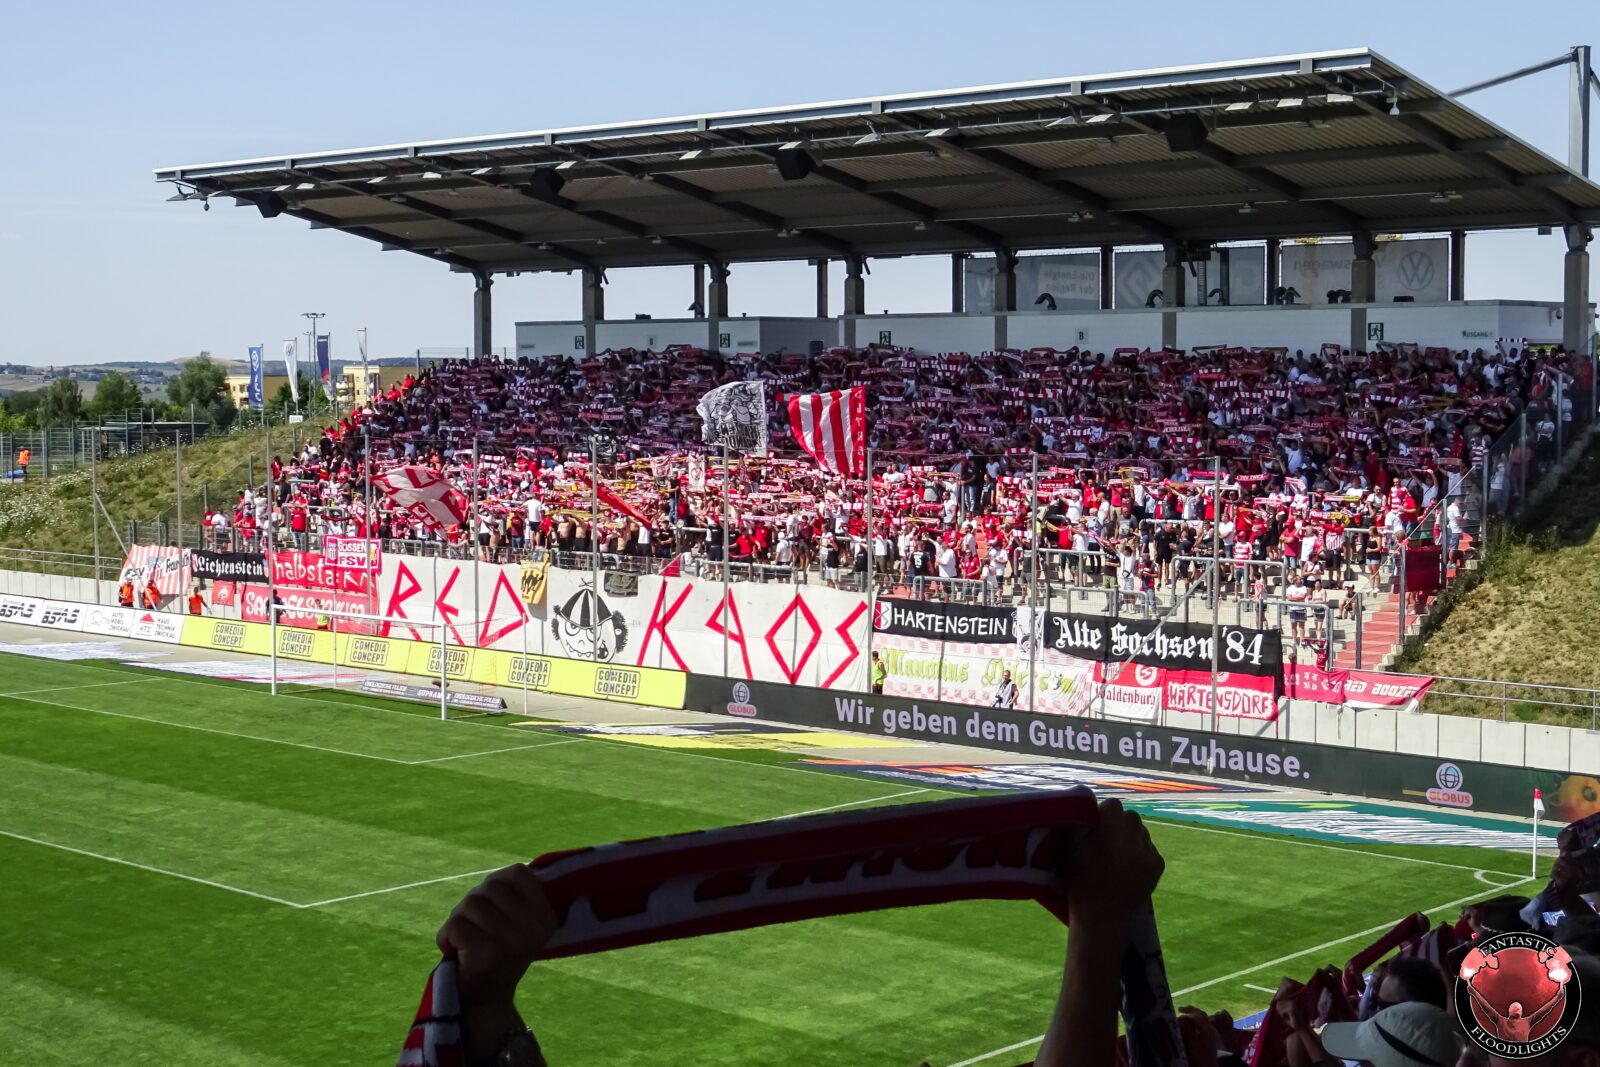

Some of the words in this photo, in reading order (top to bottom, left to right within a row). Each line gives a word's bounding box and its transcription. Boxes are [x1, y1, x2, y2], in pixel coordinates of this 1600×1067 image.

[197, 555, 263, 577] Lichtenstein
[340, 556, 366, 566] FSV
[379, 560, 529, 648] RED
[215, 623, 245, 636] COMEDIA
[893, 608, 1007, 637] HARTENSTEIN
[213, 634, 243, 645] CONCEPT
[282, 631, 313, 645] COMEDIA
[1052, 615, 1102, 650] Alte
[281, 642, 312, 655] CONCEPT
[354, 640, 387, 654] COMEDIA
[352, 651, 386, 664] CONCEPT
[429, 660, 465, 673] COCEPT
[599, 670, 637, 684] COMEDIA
[597, 681, 636, 696] CONCEPT
[728, 704, 757, 717] GLOBUS
[834, 697, 874, 726] Wir
[882, 704, 958, 736] geben
[965, 711, 1020, 744] dem
[1029, 719, 1109, 755] Guten
[1118, 730, 1161, 761] ein
[1171, 736, 1310, 780] Zuhause.
[1428, 790, 1473, 806] GLOBUS
